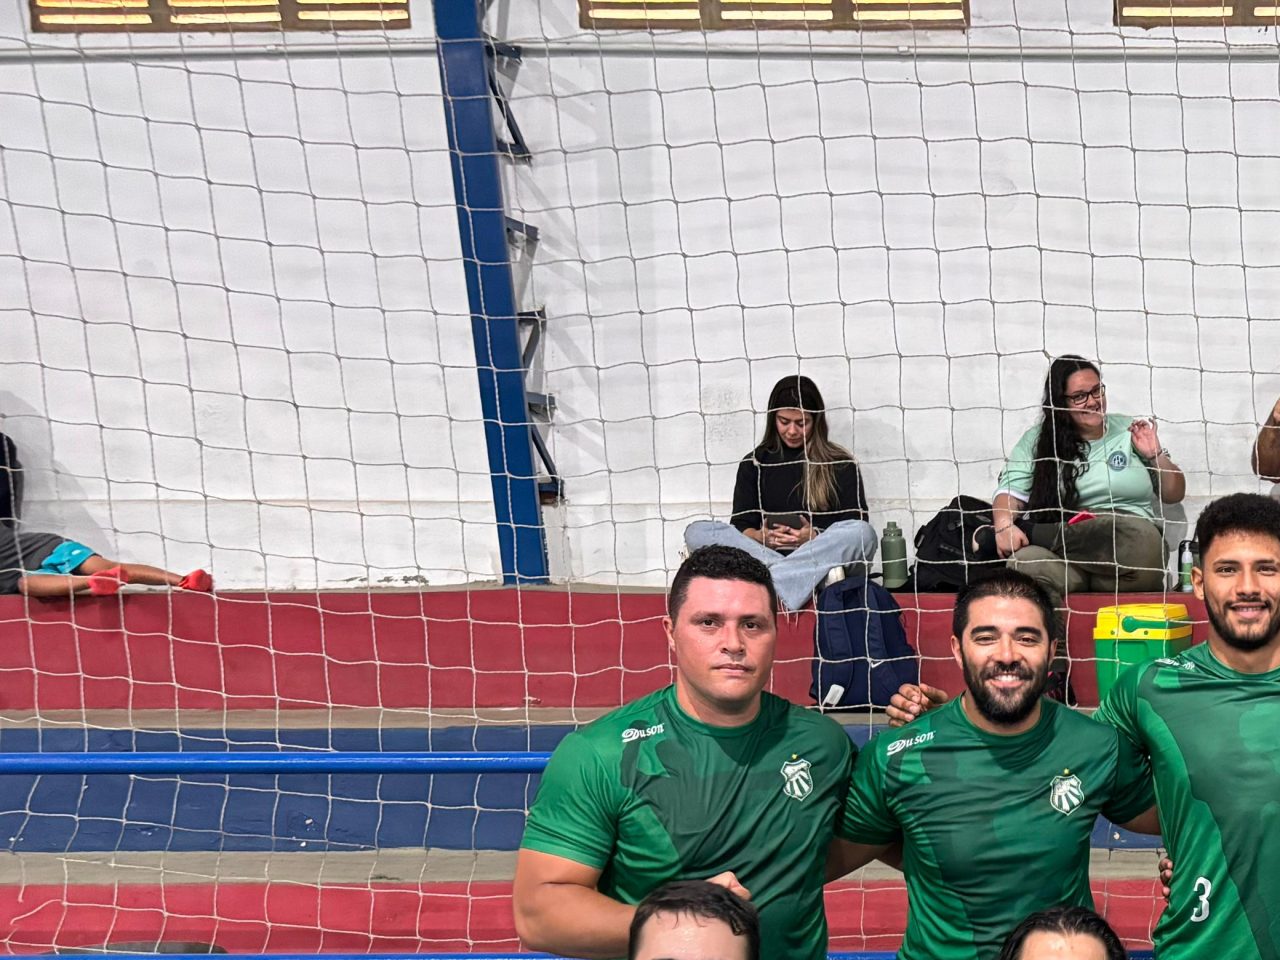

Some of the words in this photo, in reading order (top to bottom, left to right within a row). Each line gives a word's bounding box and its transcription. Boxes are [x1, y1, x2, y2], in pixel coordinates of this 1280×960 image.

[621, 723, 664, 743] Duson
[886, 731, 936, 756] Duson
[1190, 876, 1211, 922] 3
